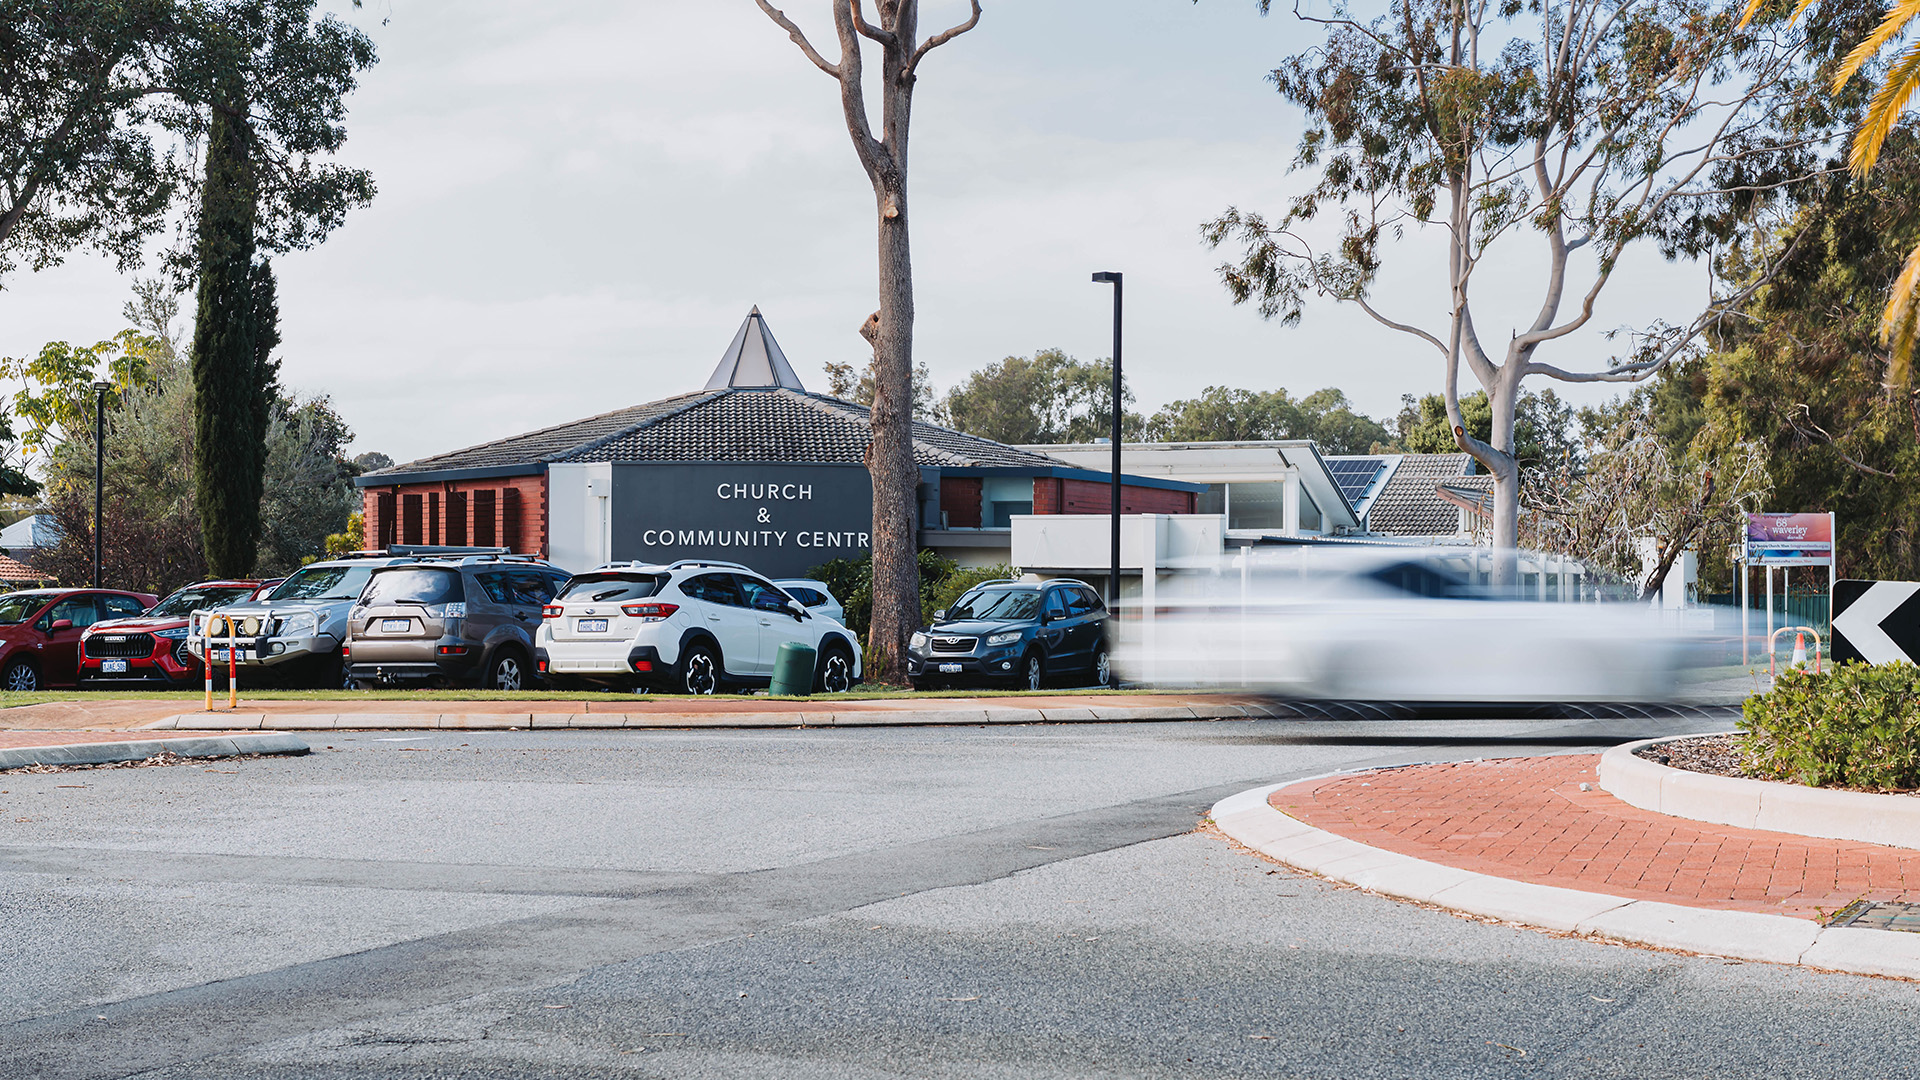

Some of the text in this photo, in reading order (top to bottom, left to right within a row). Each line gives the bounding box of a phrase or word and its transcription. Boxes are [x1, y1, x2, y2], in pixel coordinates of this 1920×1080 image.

[716, 483, 812, 500] CHURCH
[756, 507, 771, 523] &
[1776, 518, 1788, 527] 68
[642, 529, 870, 548] COMMUNITY CENTR
[1772, 525, 1808, 536] waverley
